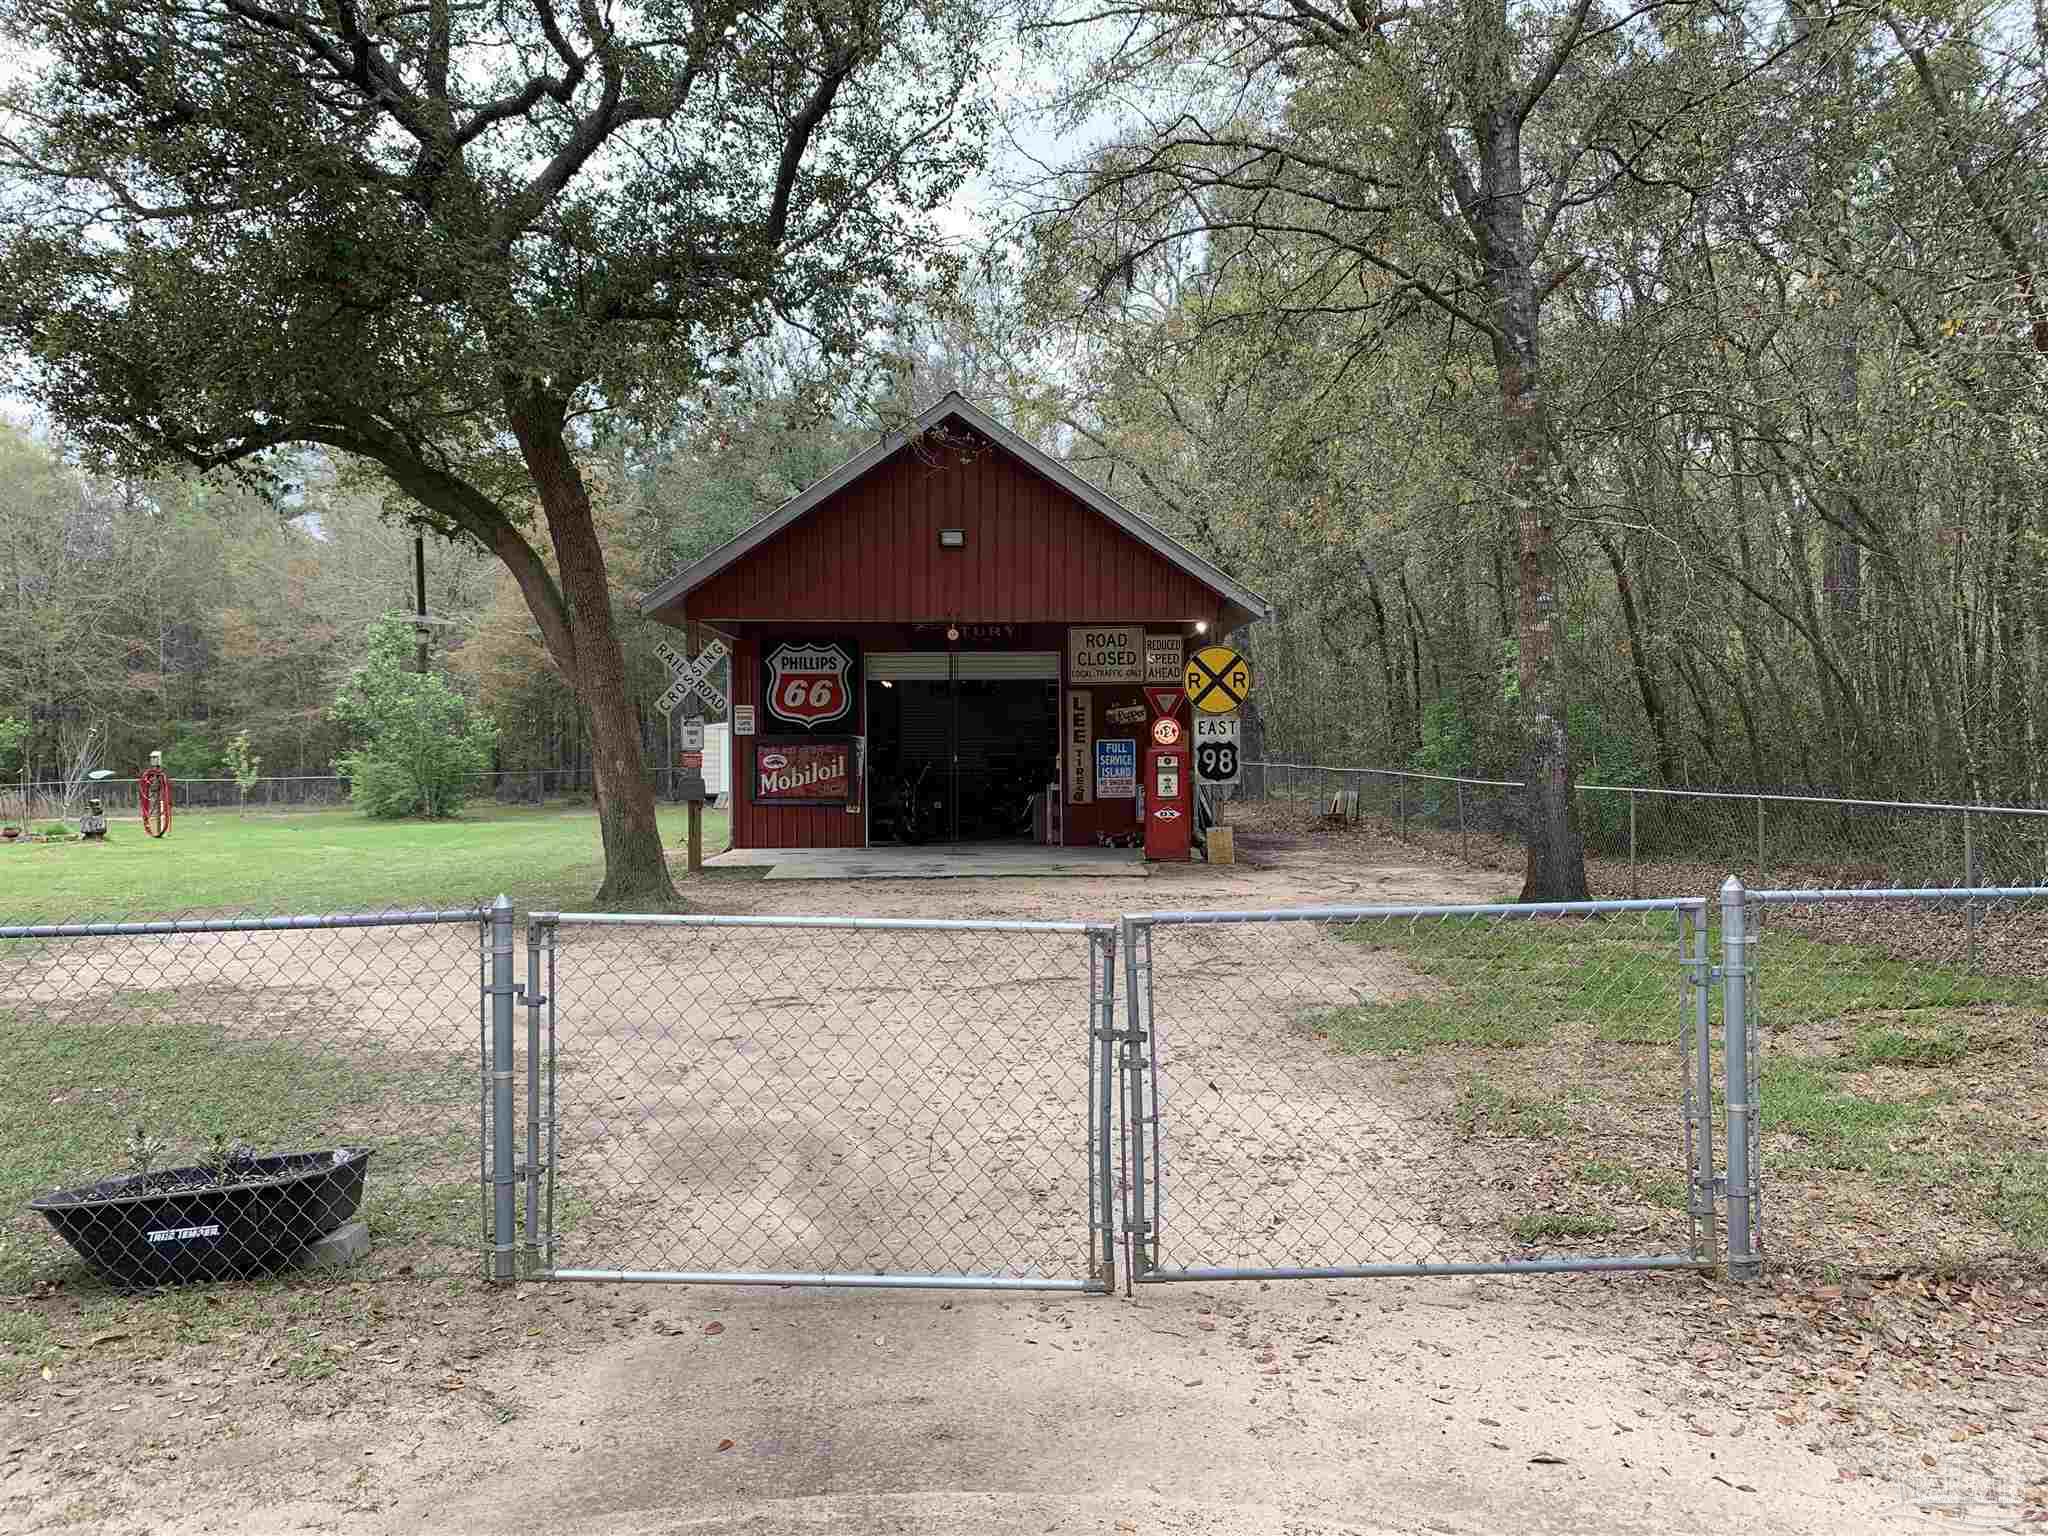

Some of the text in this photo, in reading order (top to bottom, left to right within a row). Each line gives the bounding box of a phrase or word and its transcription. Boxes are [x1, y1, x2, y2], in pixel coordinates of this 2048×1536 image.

[1086, 633, 1128, 648] ROAD
[1146, 640, 1181, 650] REDUCED
[781, 656, 838, 670] PHILLIPS
[1078, 651, 1137, 666] CLOSED
[1148, 654, 1180, 664] SPEED
[660, 643, 723, 711] CROSSING
[1148, 667, 1180, 678] AHEAD
[1188, 671, 1246, 688] R R
[784, 680, 833, 708] 66
[1073, 696, 1086, 744] LEE
[1198, 720, 1237, 735] EAST
[1106, 743, 1128, 753] FULL
[1100, 755, 1132, 766] SERVICE
[1203, 748, 1233, 774] 98
[760, 755, 845, 796] Mobiloil
[1102, 767, 1132, 778] ISLAND
